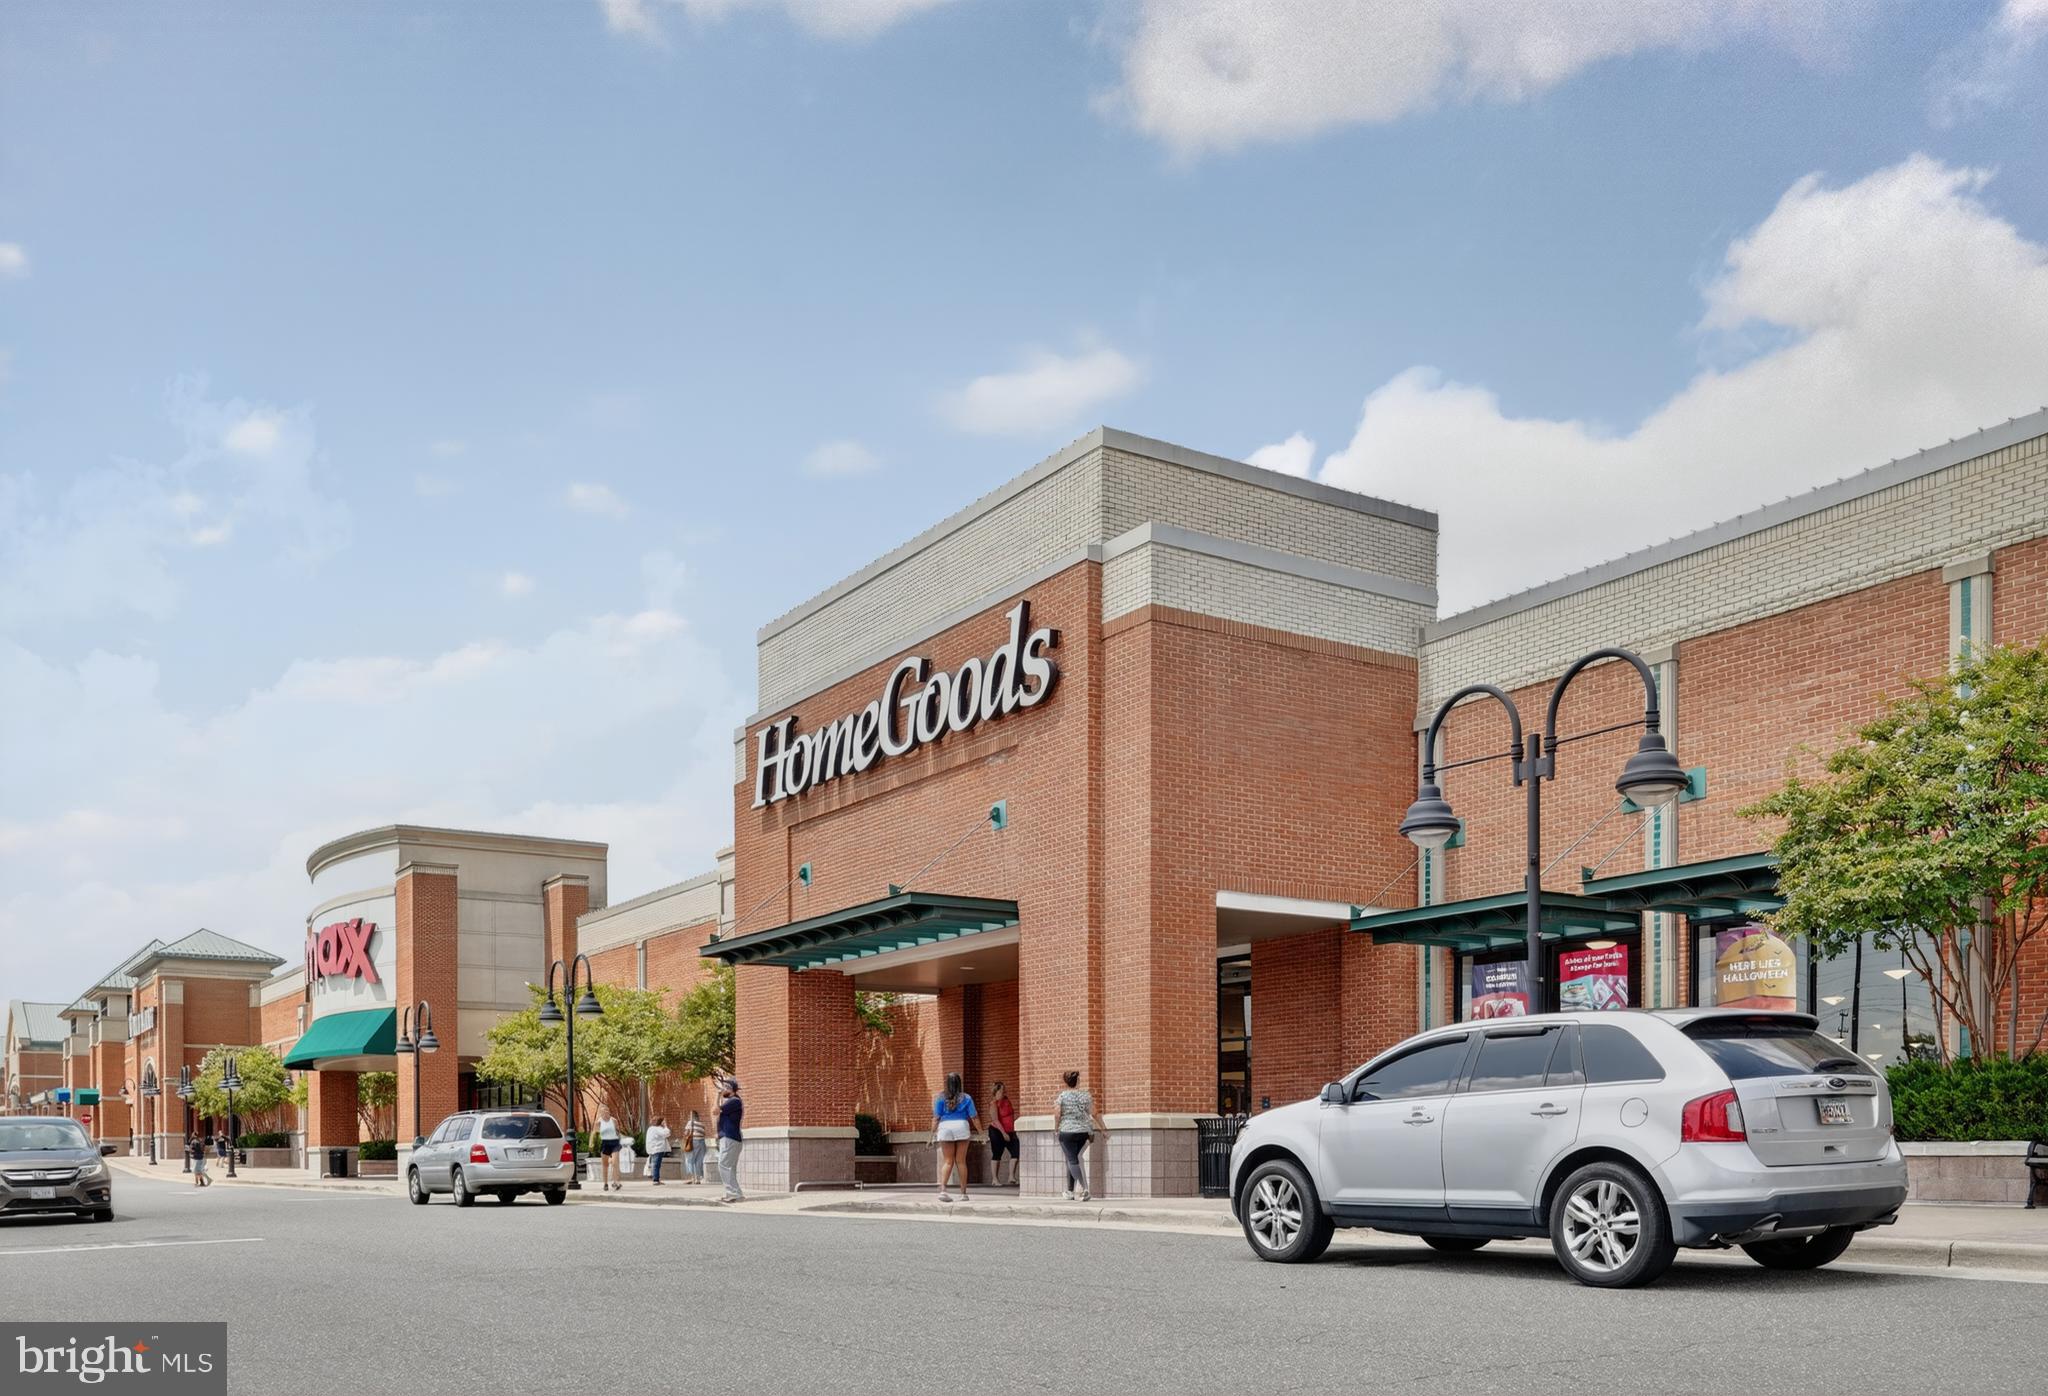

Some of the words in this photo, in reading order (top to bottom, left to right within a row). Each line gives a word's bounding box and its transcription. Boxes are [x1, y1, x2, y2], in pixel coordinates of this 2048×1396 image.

[751, 600, 1061, 809] HomeGoods
[1759, 958, 1781, 969] LIES
[1723, 969, 1788, 983] HALLOWEEN
